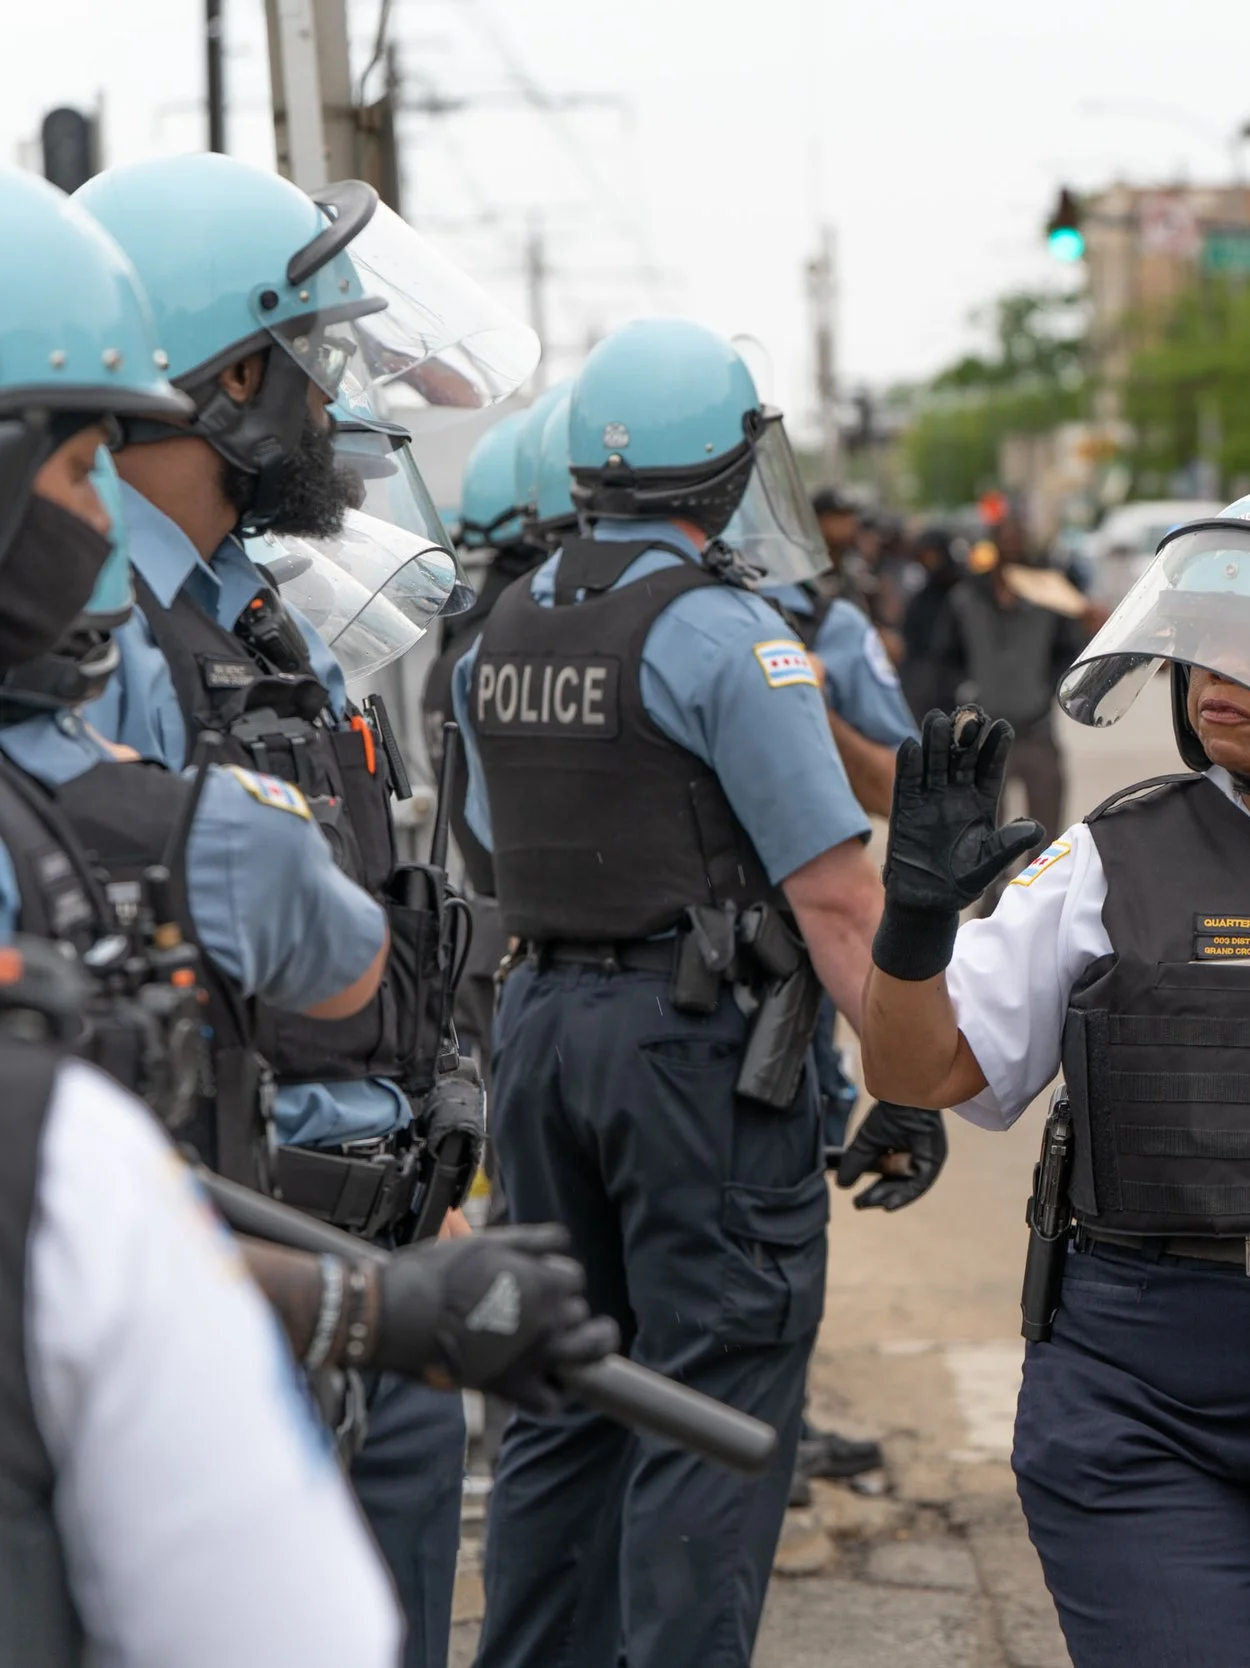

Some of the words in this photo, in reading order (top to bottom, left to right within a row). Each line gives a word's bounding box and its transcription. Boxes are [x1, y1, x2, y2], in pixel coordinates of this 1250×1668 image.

[478, 664, 606, 724] POLICE
[1213, 937, 1230, 945] 003
[1204, 947, 1234, 955] GRAND
